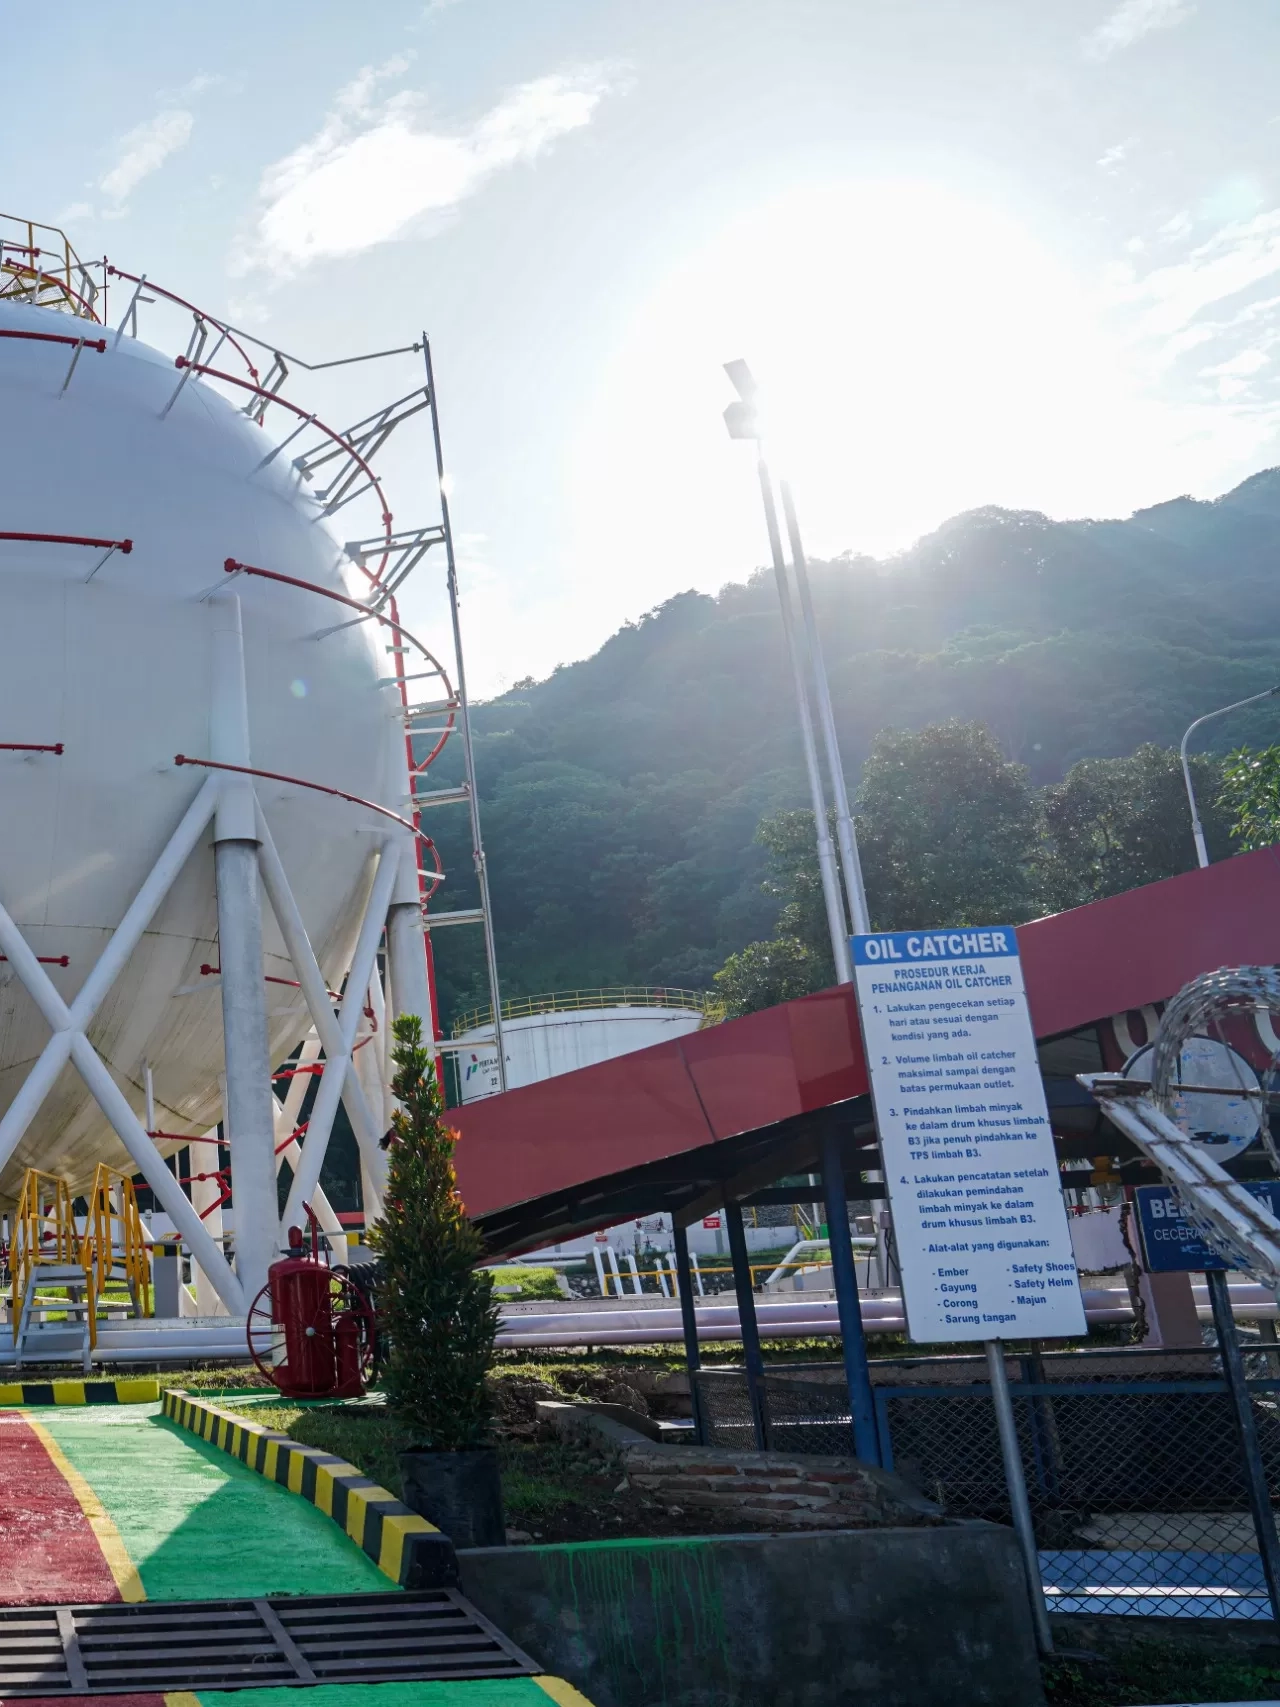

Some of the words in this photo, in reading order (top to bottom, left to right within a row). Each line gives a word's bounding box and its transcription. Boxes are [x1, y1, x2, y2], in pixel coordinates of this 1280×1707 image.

[865, 939, 902, 959] OIL
[907, 931, 1008, 957] CATCHER
[894, 967, 949, 980] PROSEDUR
[952, 965, 986, 976] KERJA
[872, 980, 942, 993] PENANGANAN
[945, 979, 962, 988] OIL
[965, 976, 1012, 987] CATCHER
[887, 1004, 926, 1012] Lakukan
[929, 1000, 984, 1011] pengecekan
[987, 998, 1015, 1006] setiap
[889, 1018, 907, 1027] hari
[933, 1015, 962, 1024] sesuai
[965, 1014, 998, 1023] dengan
[892, 1032, 924, 1040] kondisi
[927, 1032, 949, 1041] yang
[952, 1029, 971, 1037] ada.
[882, 1056, 890, 1065] 2.
[933, 1053, 964, 1062] limbah
[967, 1052, 978, 1060] oil
[981, 1051, 1015, 1060] catcher
[898, 1068, 942, 1078] maksimal
[946, 1066, 979, 1077] sampai
[982, 1066, 1015, 1077] dengan
[929, 1082, 981, 1093] permukaan
[984, 1080, 1014, 1088] outlet.
[904, 1107, 952, 1116] Pindahkan
[955, 1104, 986, 1113] limbah
[989, 1102, 1023, 1113] minyak
[951, 1120, 975, 1128] drum
[978, 1119, 1011, 1127] khusus
[1013, 1116, 1045, 1125] limbah
[908, 1137, 920, 1145] B3
[923, 1136, 940, 1147] jika
[943, 1134, 971, 1145] penuh
[975, 1133, 1023, 1144] pindahkan
[910, 1151, 928, 1160] TPS
[932, 1150, 963, 1159] limbah
[966, 1149, 981, 1157] B3.
[900, 1176, 909, 1184] 4.
[914, 1174, 954, 1183] Lakukan
[958, 1172, 1011, 1183] pencatatan
[1014, 1168, 1048, 1178] setelah
[917, 1189, 963, 1198] dilakukan
[966, 1186, 1023, 1197] pemindahan
[919, 1204, 951, 1213] limbah
[954, 1202, 988, 1212] minyak
[990, 1201, 1002, 1209] ke
[1005, 1200, 1034, 1208] dalam
[922, 1220, 946, 1228] drum
[949, 1219, 983, 1227] khusus
[985, 1216, 1017, 1225] limbah
[1020, 1215, 1035, 1223] B3.
[929, 1243, 969, 1252] Alat-alat
[972, 1243, 994, 1252] yang
[997, 1239, 1049, 1250] digunakan:
[938, 1268, 968, 1276] Ember
[1012, 1264, 1042, 1274] Safety
[1046, 1263, 1075, 1271] Shoes
[941, 1284, 977, 1293] Gayung
[1014, 1280, 1044, 1289] Safety
[1048, 1278, 1073, 1286] Helm
[943, 1299, 978, 1309] Corong
[1017, 1296, 1046, 1306] Majun
[946, 1315, 980, 1324] Sarung
[983, 1314, 1016, 1323] tangan
